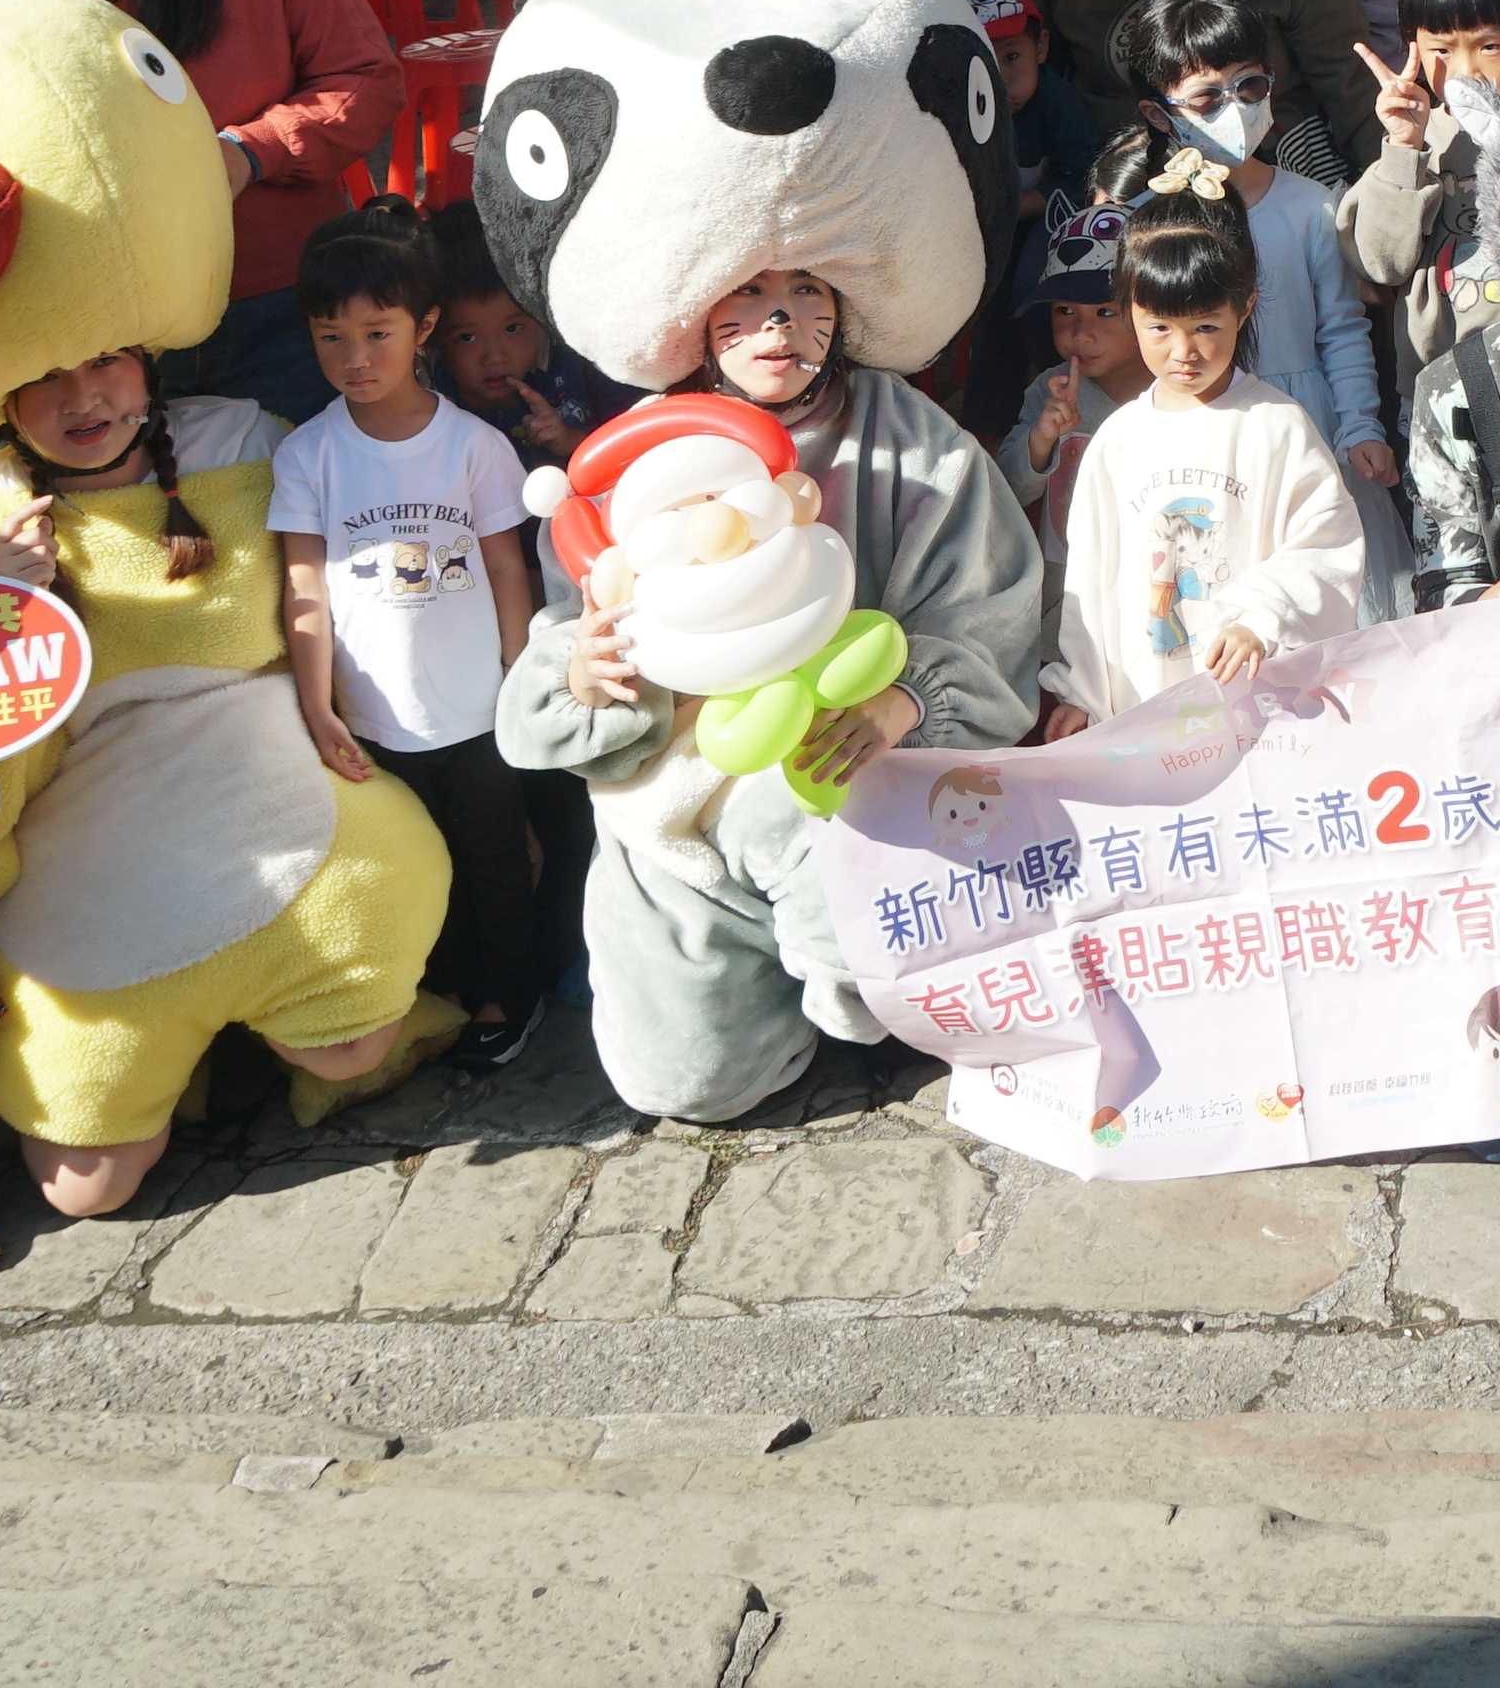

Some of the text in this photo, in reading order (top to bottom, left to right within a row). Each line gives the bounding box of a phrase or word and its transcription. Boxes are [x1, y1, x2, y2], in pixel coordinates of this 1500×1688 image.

[1168, 467, 1248, 502] LETTER
[342, 503, 434, 535] NAUGHTY
[392, 524, 430, 535] THREE
[1161, 732, 1313, 776] Happy Family
